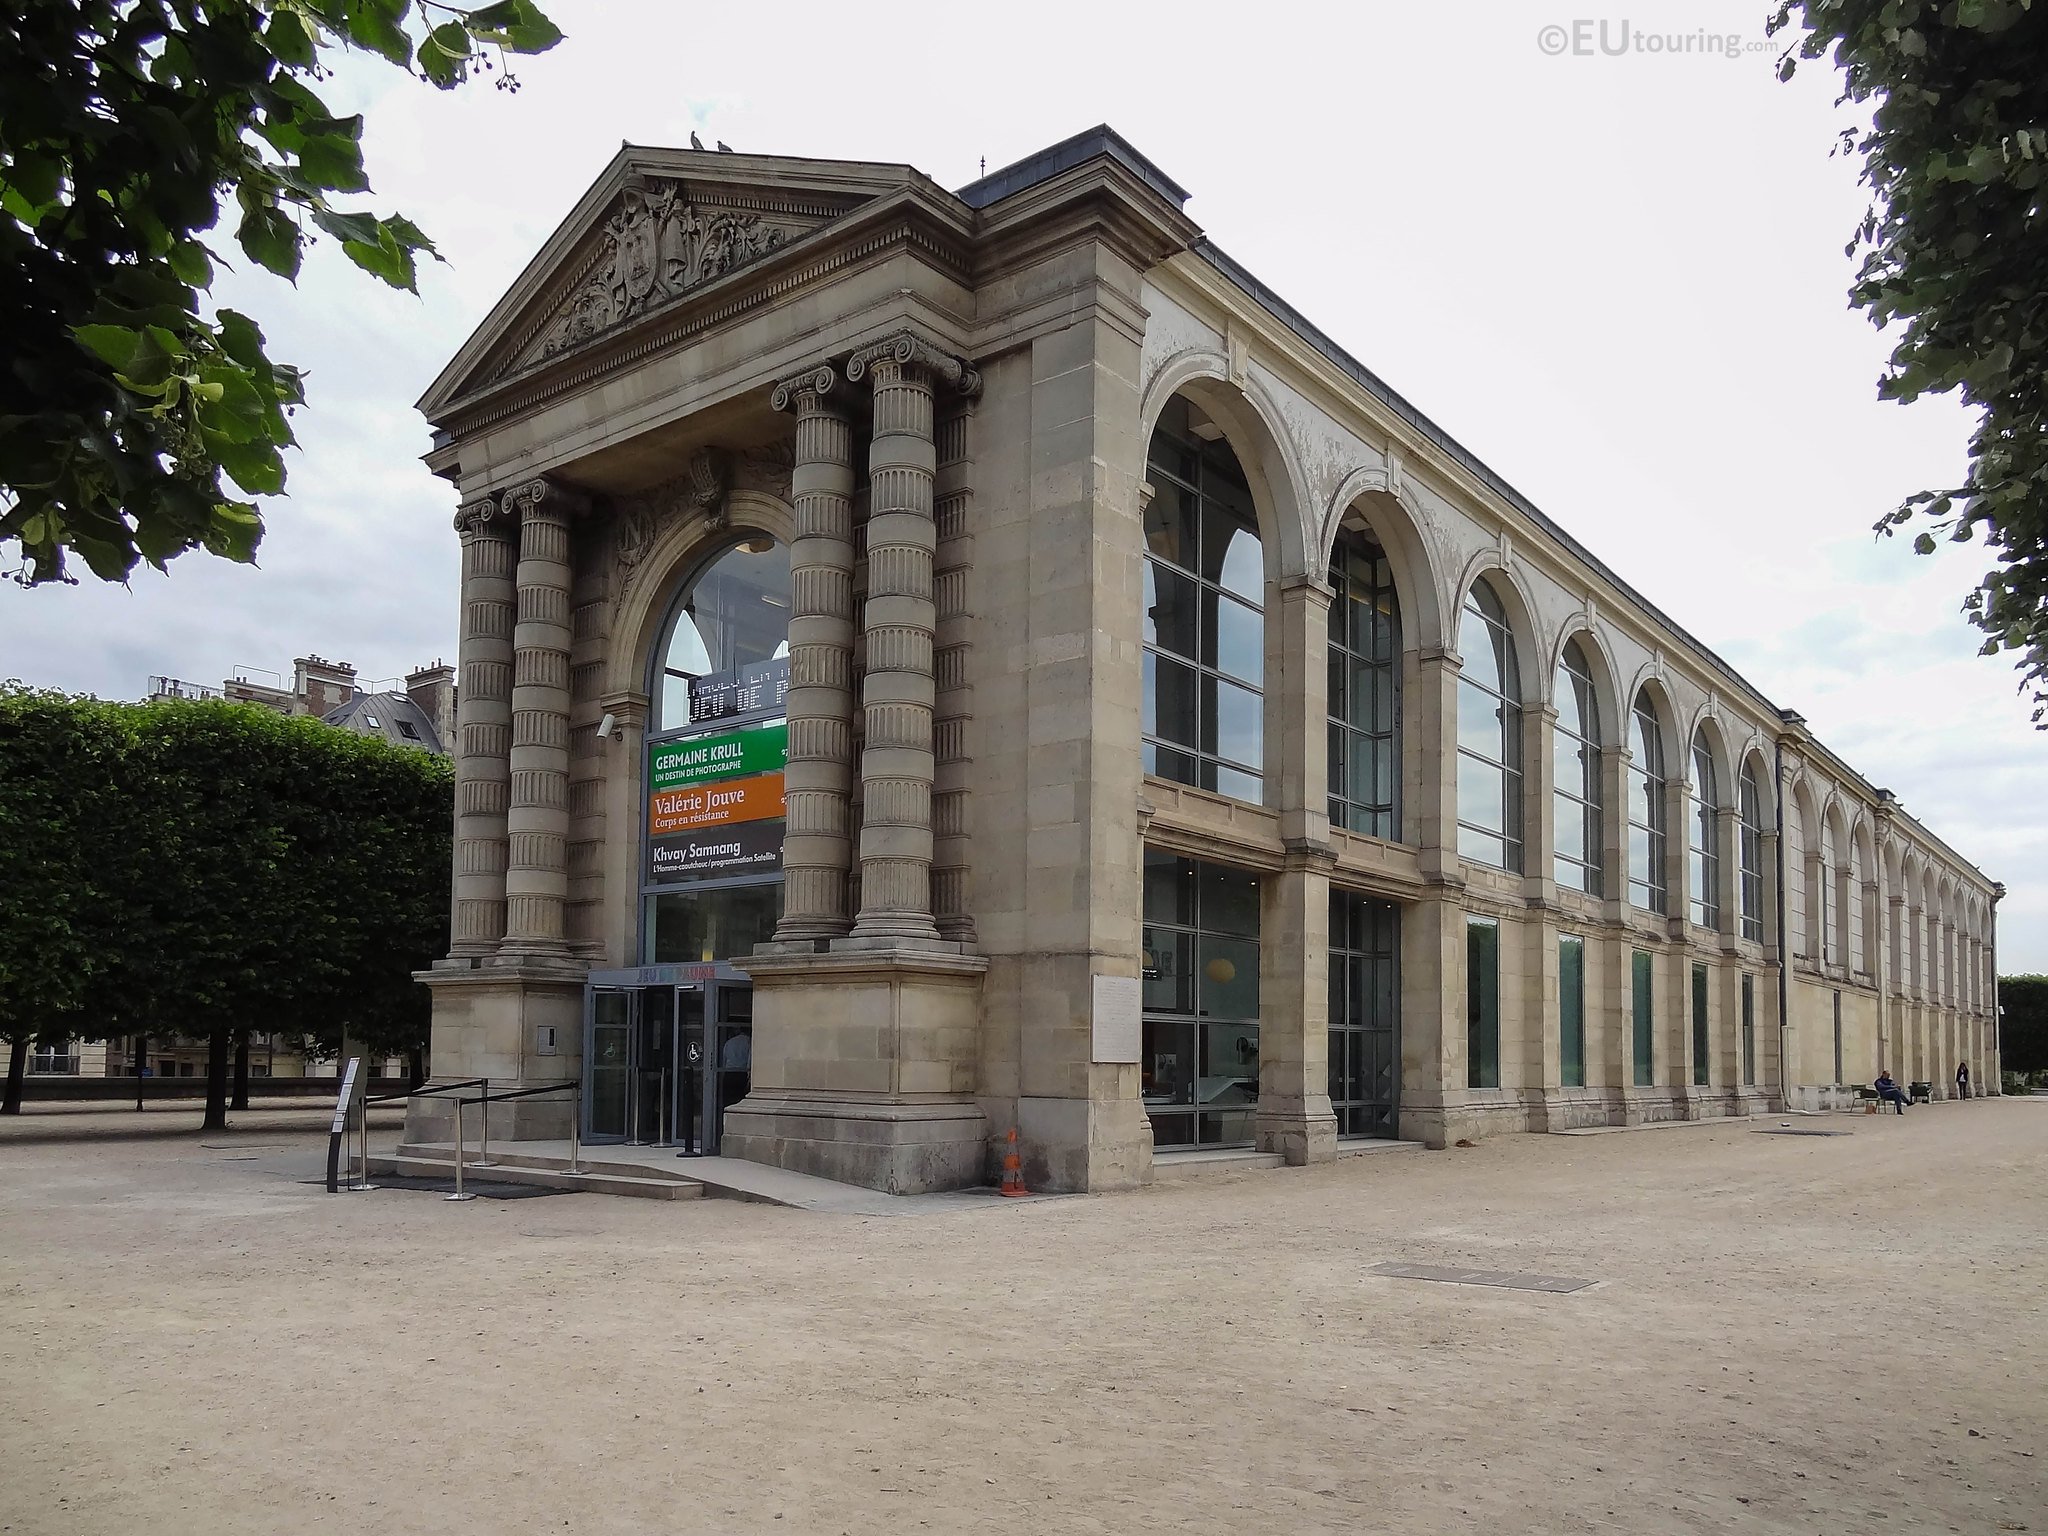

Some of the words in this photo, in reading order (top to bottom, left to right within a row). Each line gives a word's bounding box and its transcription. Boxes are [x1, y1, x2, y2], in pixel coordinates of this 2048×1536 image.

[689, 693, 724, 721] JEU
[737, 687, 762, 712] DE
[656, 748, 708, 770] GERMAINE
[710, 742, 744, 761] KRULL
[655, 773, 664, 782] UN
[665, 769, 686, 781] DESTIN
[686, 767, 695, 777] DE
[695, 760, 742, 776] PHOTOGRAPHE
[655, 793, 702, 815] Valérie
[705, 789, 745, 812] Jouve
[655, 817, 677, 829] Corps
[678, 815, 689, 825] en
[690, 810, 729, 823] résistance
[653, 846, 687, 863] Khvay
[689, 843, 741, 857] Samnang
